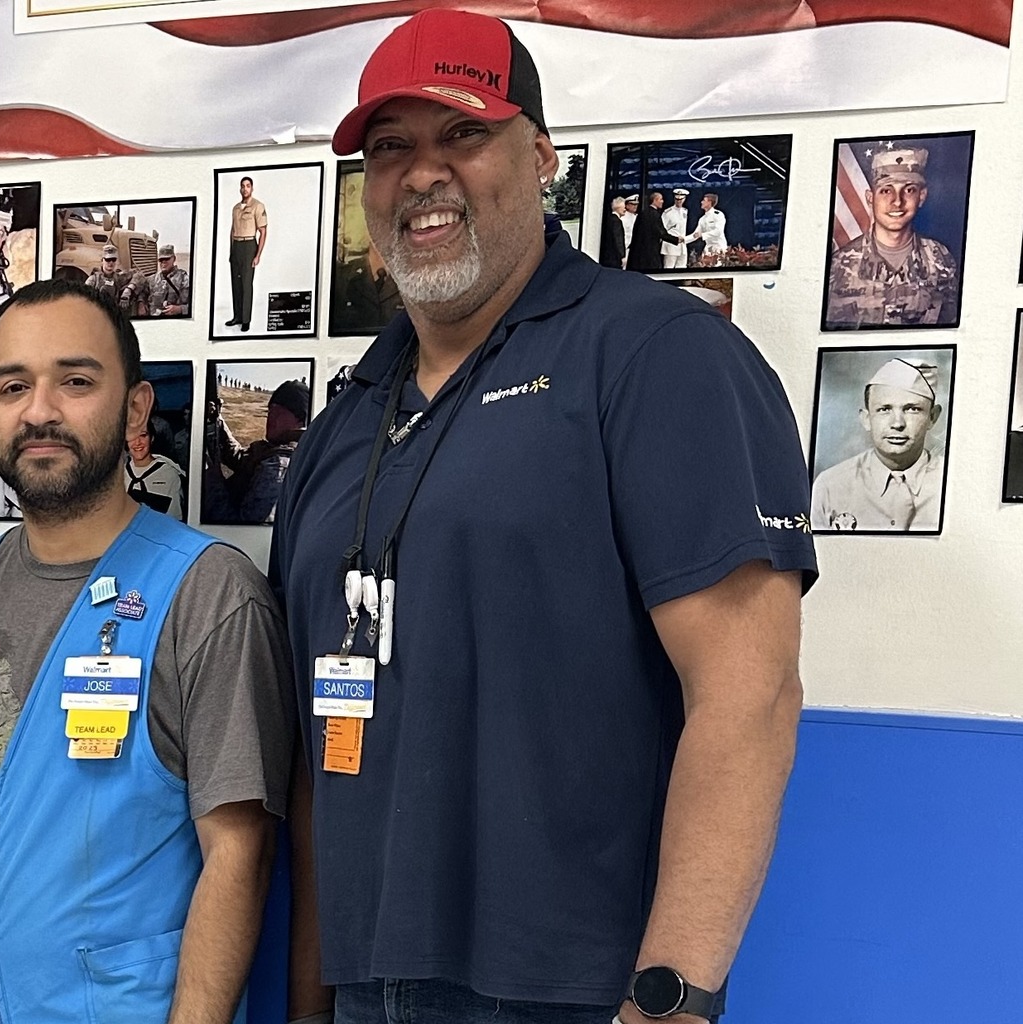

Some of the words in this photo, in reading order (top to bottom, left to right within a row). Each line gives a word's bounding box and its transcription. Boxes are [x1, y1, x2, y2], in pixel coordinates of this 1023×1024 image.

[434, 62, 486, 82] Hurley
[481, 383, 529, 404] Walmart
[84, 680, 113, 692] JOSE
[323, 681, 365, 697] SANTOS
